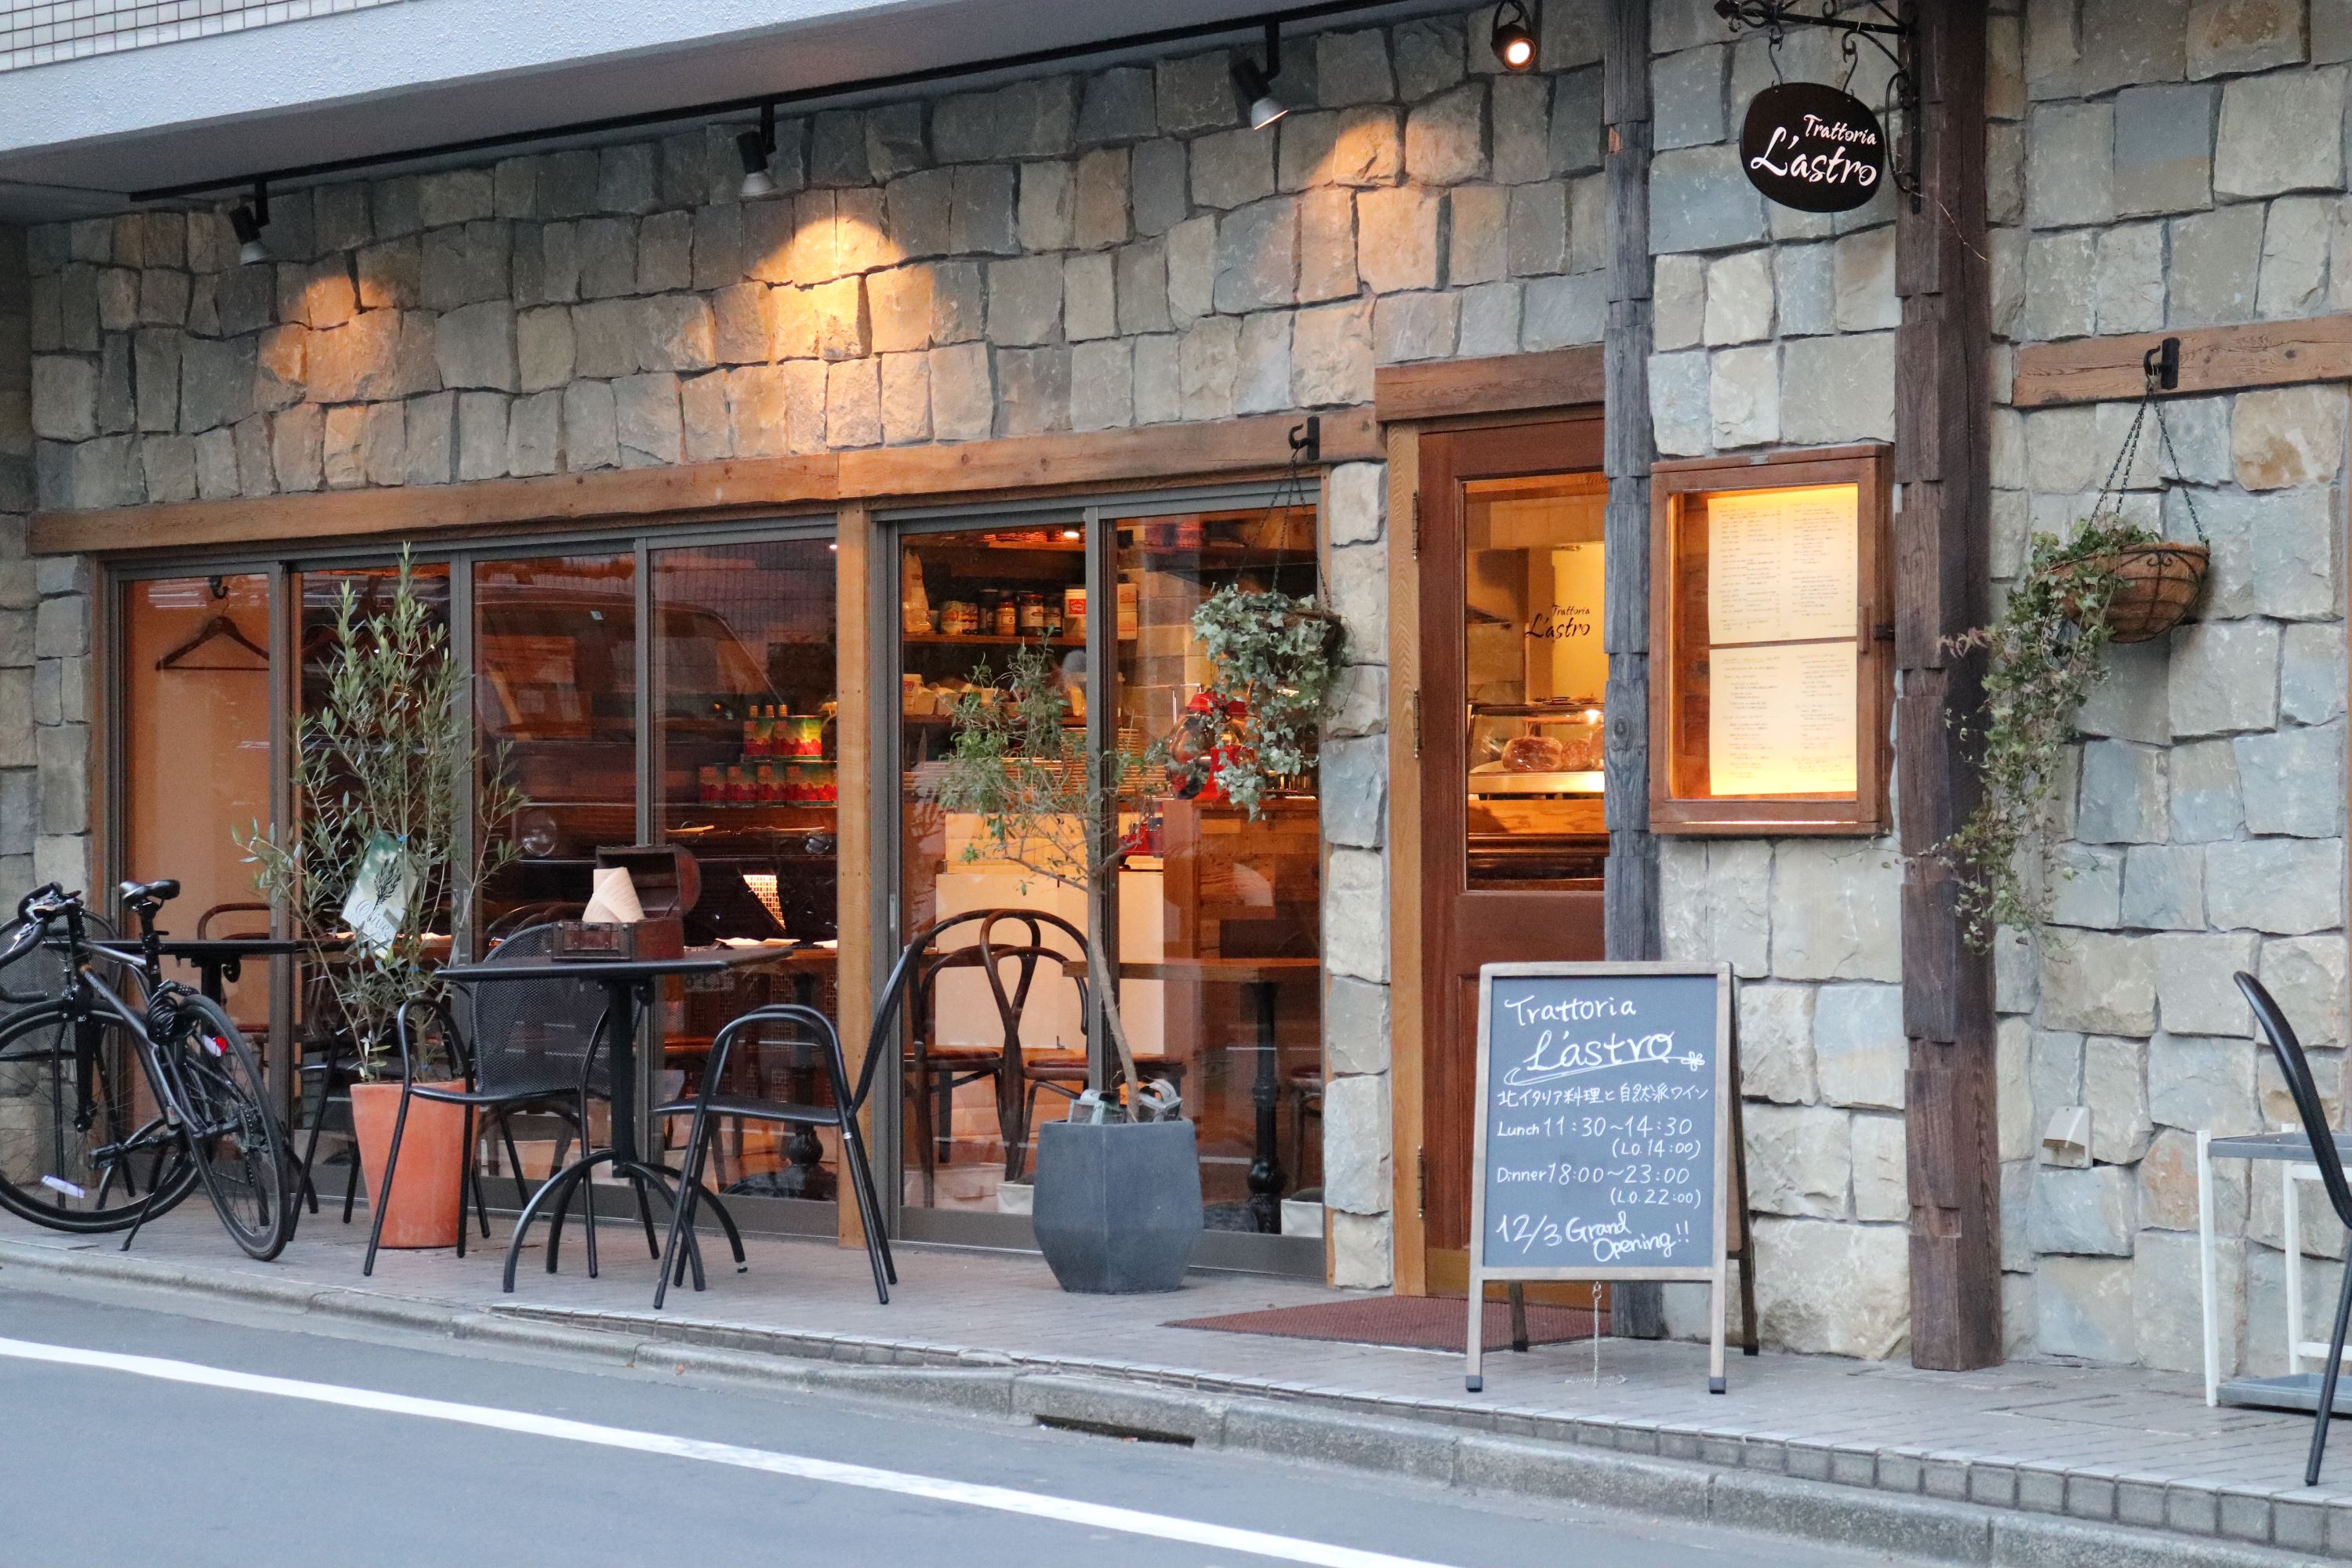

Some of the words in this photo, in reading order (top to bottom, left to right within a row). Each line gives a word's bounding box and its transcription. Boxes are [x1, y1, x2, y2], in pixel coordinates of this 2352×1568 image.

[1803, 114, 1877, 145] Trattoria
[1750, 126, 1877, 187] L'astro
[1552, 603, 1590, 615] Trattoria
[1525, 613, 1590, 639] L'astro
[1504, 995, 1636, 1026] Trattoria
[1497, 1121, 1540, 1137] Lunch
[1497, 1167, 1546, 1183] Dinner
[1496, 1214, 1563, 1254] 12/3
[1565, 1210, 1632, 1243] Grand
